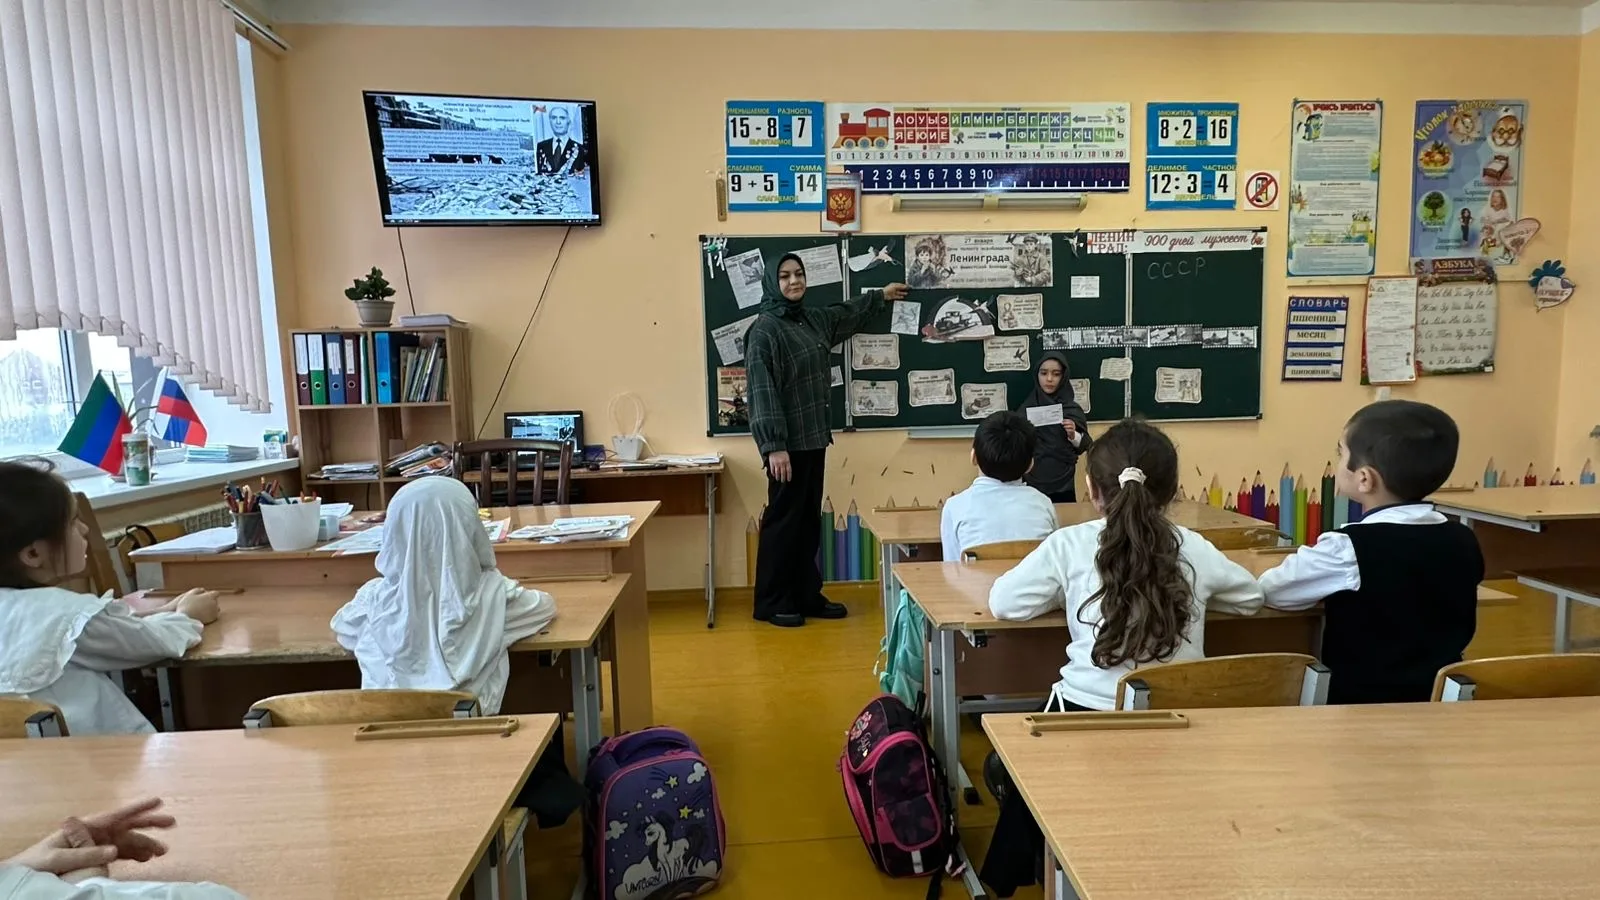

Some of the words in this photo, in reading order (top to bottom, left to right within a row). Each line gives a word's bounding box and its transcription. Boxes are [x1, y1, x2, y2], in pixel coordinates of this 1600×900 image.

[895, 116, 903, 124] А
[907, 116, 915, 124] О
[918, 116, 926, 124] У
[928, 116, 938, 124] Ы
[940, 116, 948, 124] Э
[963, 116, 970, 124] Л
[974, 116, 981, 124] М
[986, 116, 992, 124] Н
[997, 116, 1003, 124] Р
[1008, 116, 1014, 124] Б
[1019, 116, 1026, 124] В
[1030, 116, 1036, 124] Г
[1041, 116, 1048, 124] Д
[1051, 116, 1060, 124] Ж
[1063, 116, 1070, 124] З
[1116, 116, 1125, 124] Ъ
[730, 117, 750, 138] 15
[767, 117, 777, 138] 8
[797, 117, 806, 138] 7
[1161, 119, 1169, 139] 8
[1183, 119, 1192, 139] 2
[1210, 119, 1227, 139] 16
[896, 132, 904, 140] Я
[918, 132, 926, 140] Ю
[930, 132, 938, 140] И
[941, 132, 948, 140] Е
[1008, 131, 1014, 139] П
[1018, 131, 1026, 139] Ф
[1030, 131, 1036, 139] К
[1042, 131, 1048, 139] Т
[1051, 131, 1060, 139] Ш
[1063, 131, 1070, 139] С
[1074, 131, 1080, 139] Х
[1084, 131, 1092, 142] Ц
[1096, 131, 1102, 139] Ч
[836, 152, 842, 160] 0
[851, 152, 855, 160] 1
[865, 152, 870, 160] 2
[880, 152, 884, 160] 3
[894, 152, 898, 160] 4
[908, 152, 912, 160] 5
[922, 152, 926, 160] 6
[936, 152, 941, 160] 7
[873, 170, 880, 180] 2
[886, 170, 892, 180] 3
[900, 170, 906, 180] 4
[914, 170, 920, 180] 5
[928, 169, 934, 180] 6
[942, 169, 948, 180] 7
[956, 169, 962, 180] 8
[970, 169, 976, 180] 9
[982, 169, 994, 180] 10
[1050, 168, 1060, 179] 15
[1064, 168, 1074, 179] 16
[731, 174, 742, 192] 9
[763, 174, 774, 192] 5
[796, 174, 818, 192] 14
[1151, 174, 1171, 193] 12
[1187, 174, 1197, 193] 3
[1217, 173, 1228, 193] 4
[1091, 232, 1135, 243] ЛЕНИН
[1144, 234, 1168, 247] 900
[1169, 235, 1194, 251] дней
[950, 254, 1010, 264] Ленинграда
[1434, 260, 1474, 269] АЗБУКА
[1147, 256, 1206, 280] СССР
[1289, 299, 1347, 308] СЛОВАРЬ
[1293, 315, 1337, 323] пшеница
[1297, 331, 1326, 339] месяц
